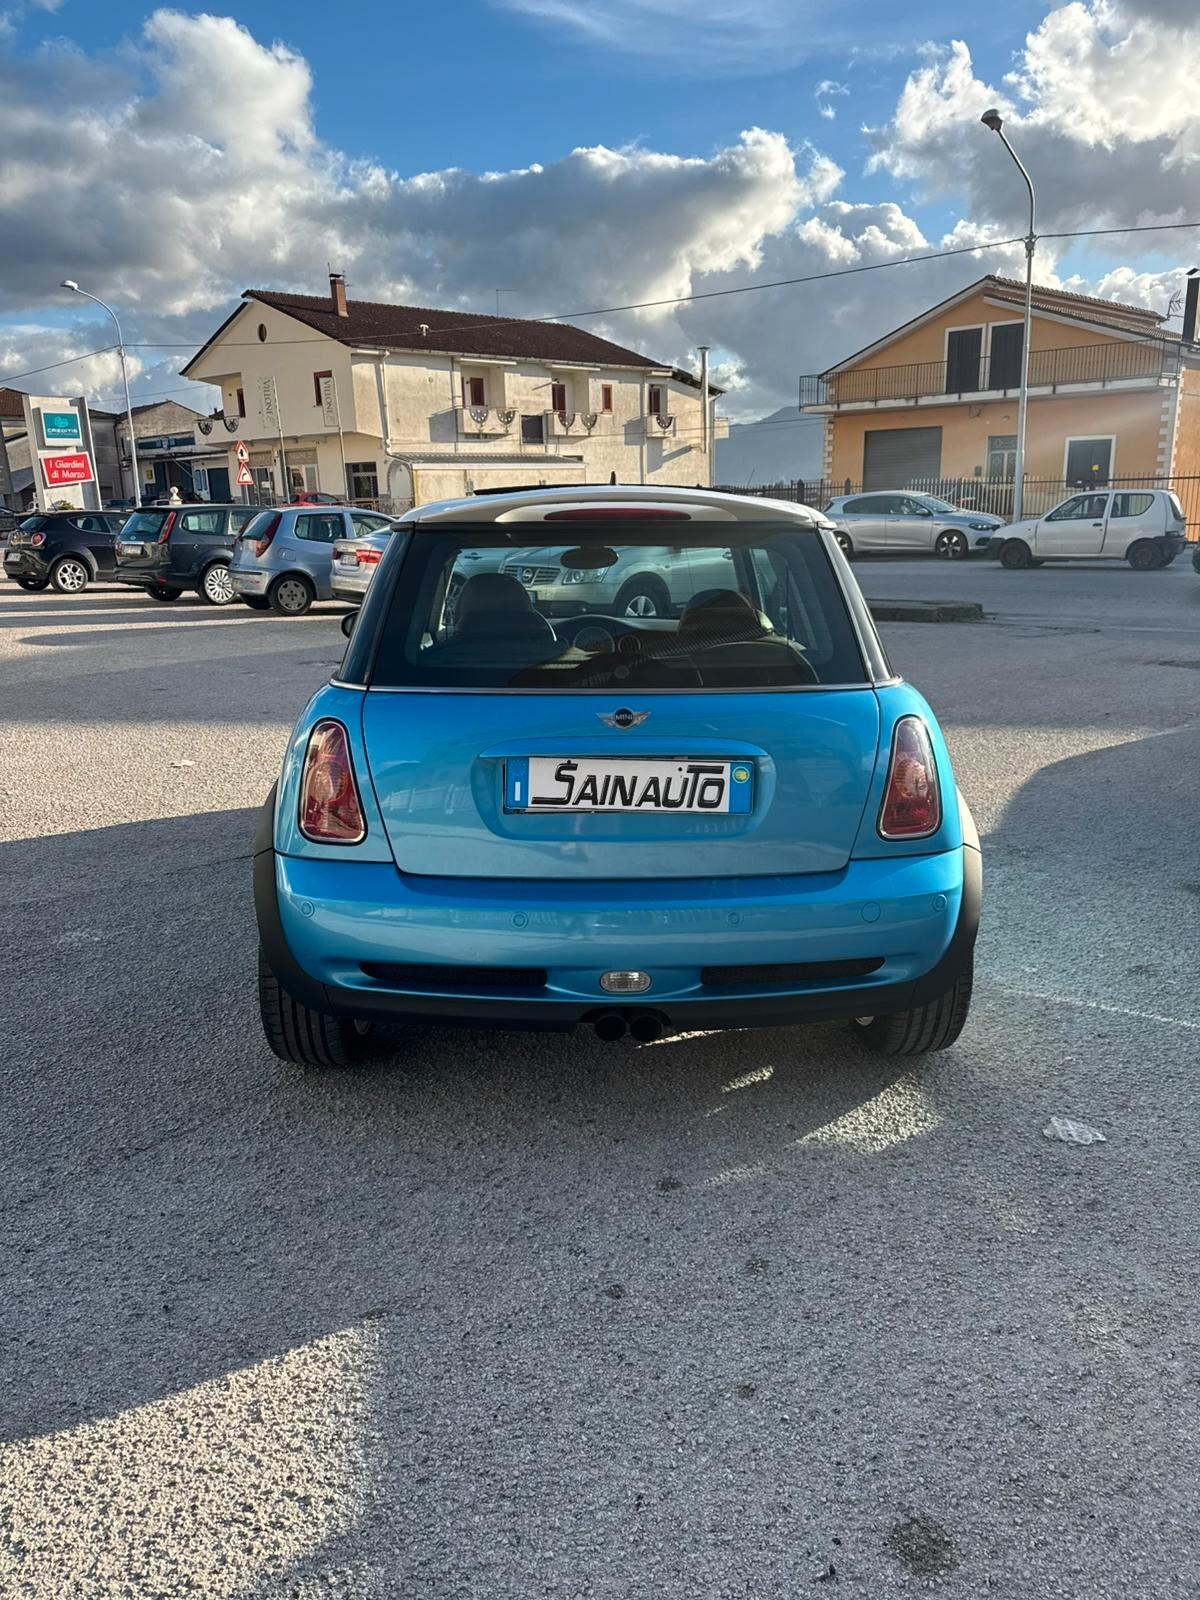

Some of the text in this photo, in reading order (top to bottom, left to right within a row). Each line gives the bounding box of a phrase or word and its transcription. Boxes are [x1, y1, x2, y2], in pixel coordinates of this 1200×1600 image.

[55, 459, 85, 469] Giardini
[51, 471, 86, 479] di Marzo
[531, 759, 725, 809] SAINAUTO
